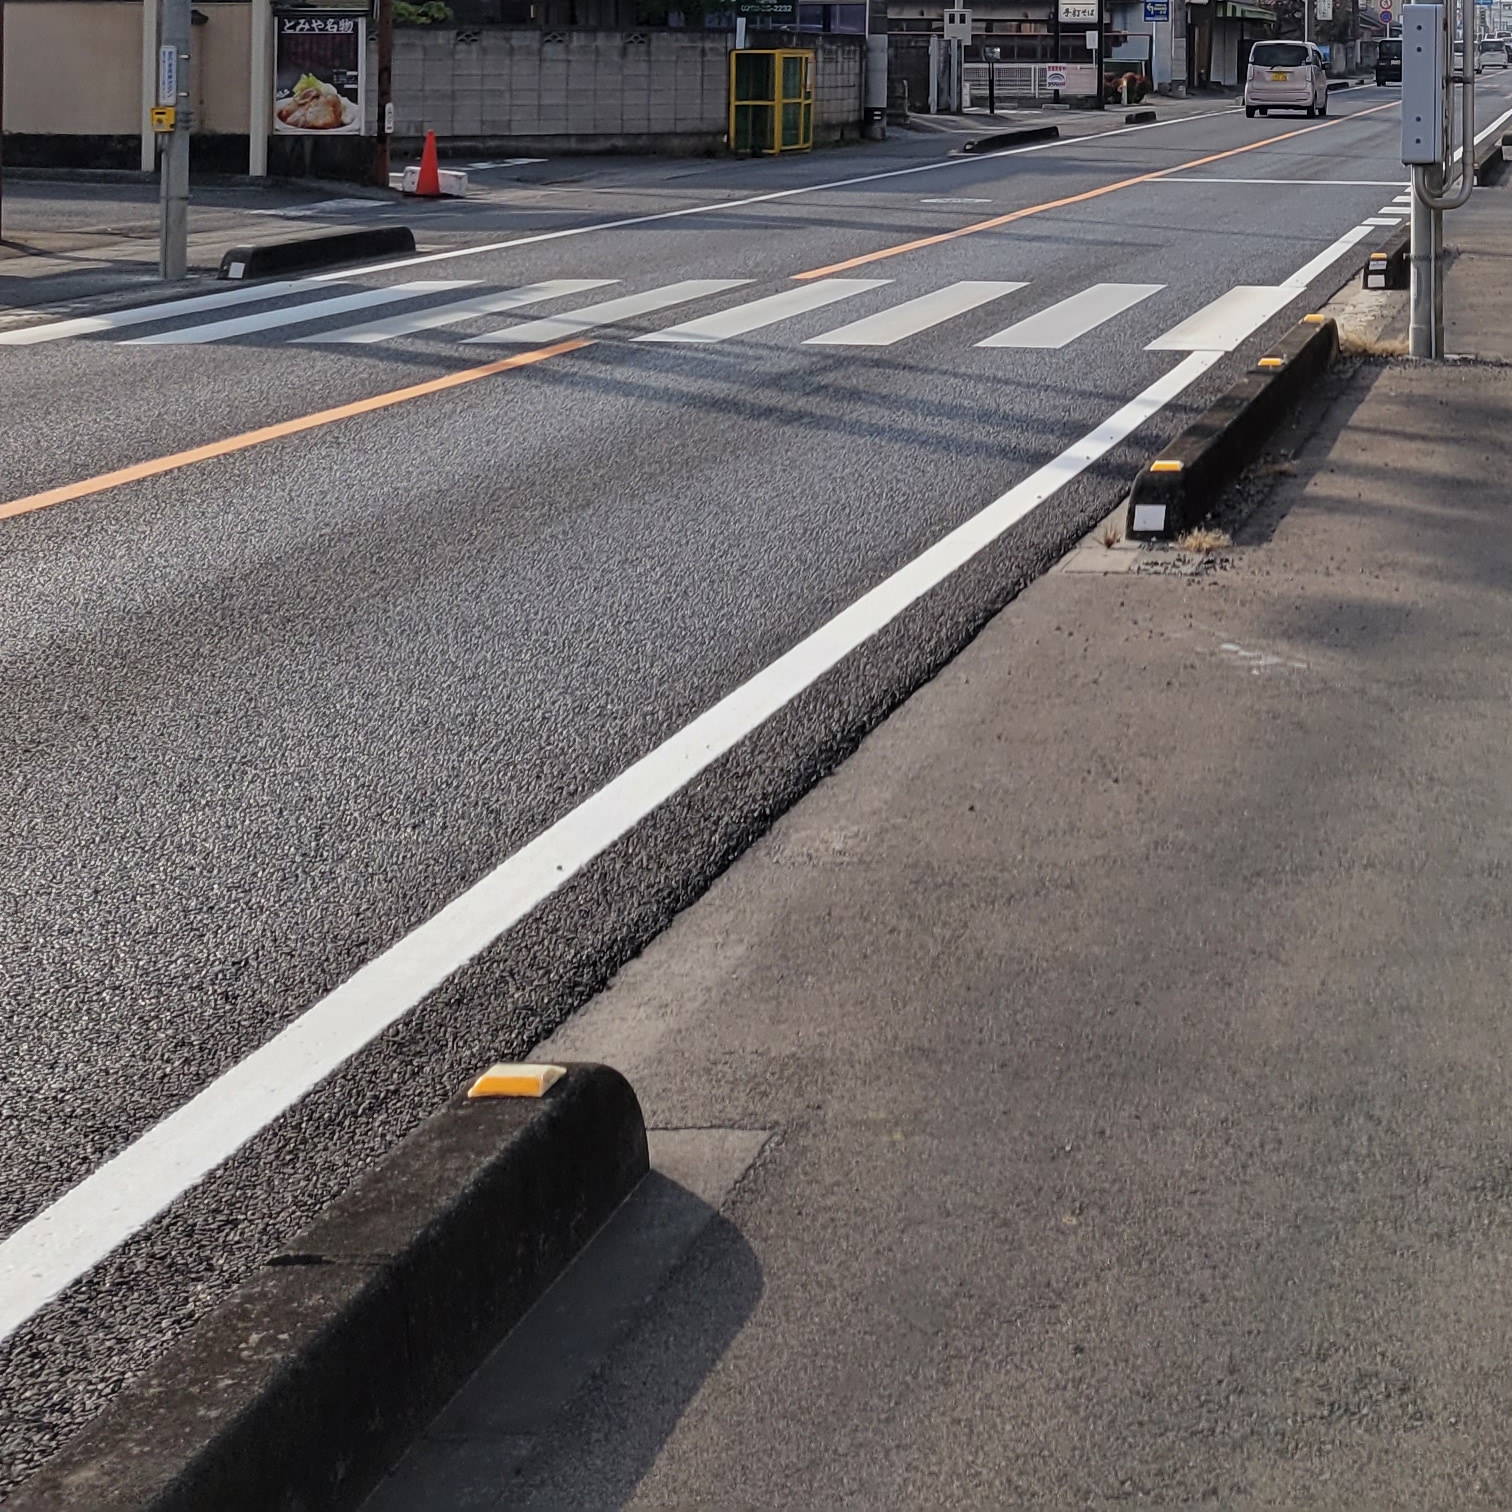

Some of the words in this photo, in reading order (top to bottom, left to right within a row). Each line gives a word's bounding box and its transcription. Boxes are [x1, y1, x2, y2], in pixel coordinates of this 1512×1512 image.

[1062, 7, 1095, 18] 手打そば
[283, 18, 354, 32] とみや名物
